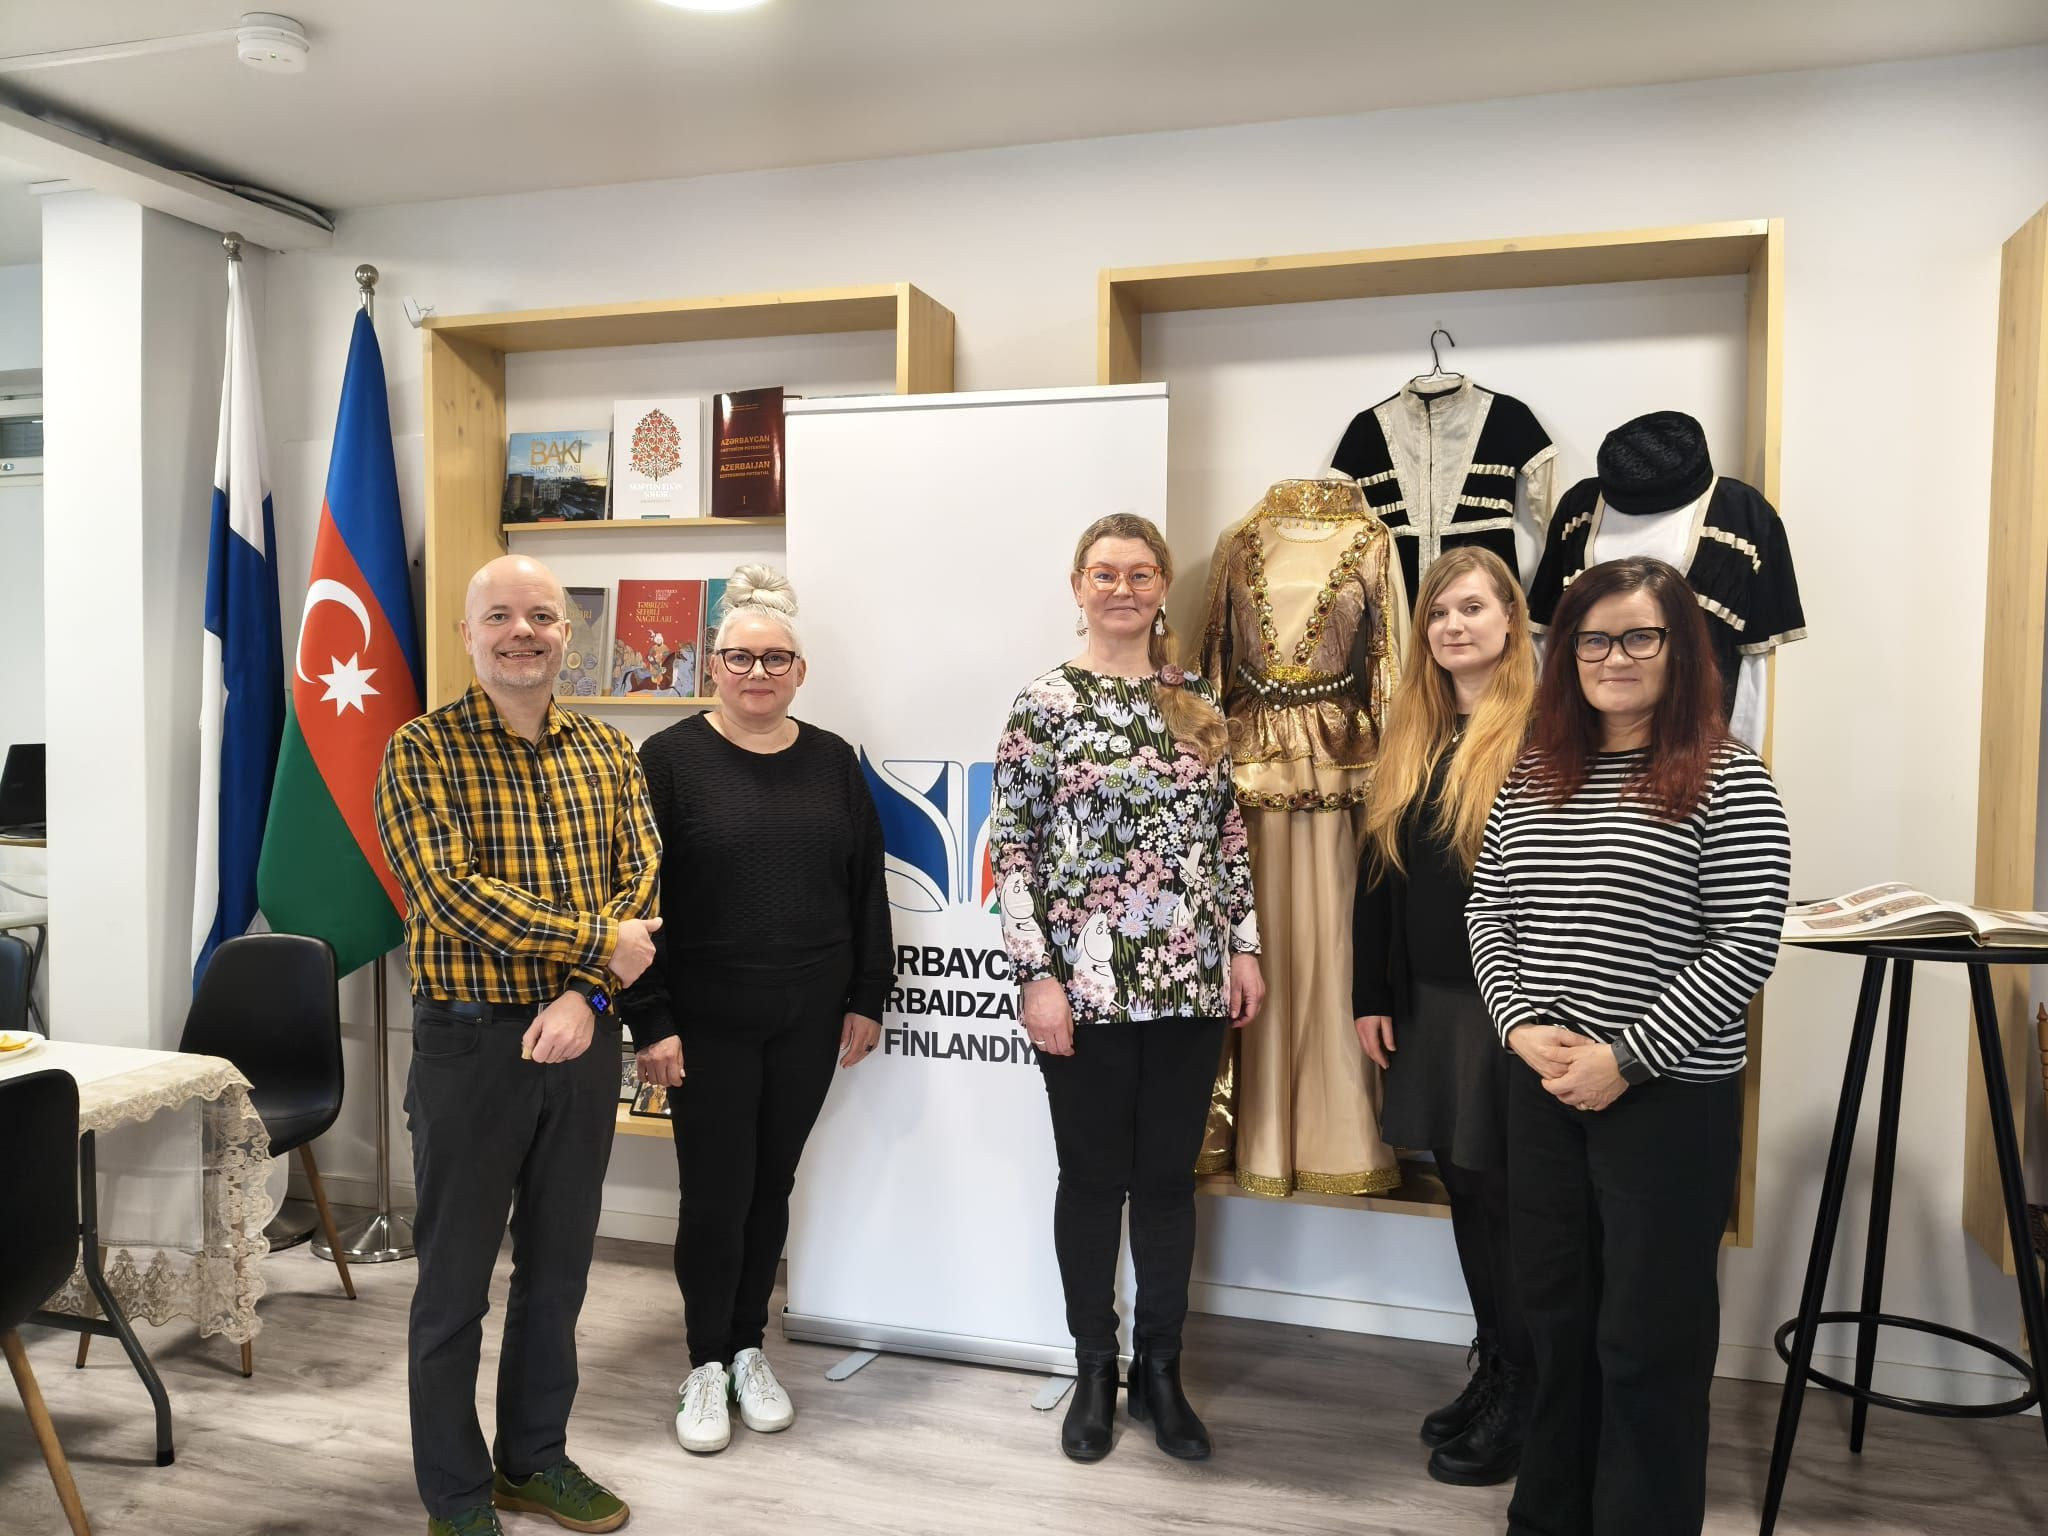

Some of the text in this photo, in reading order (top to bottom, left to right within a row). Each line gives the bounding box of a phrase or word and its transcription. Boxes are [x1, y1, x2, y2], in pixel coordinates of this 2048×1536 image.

[531, 439, 582, 465] BAKI
[720, 434, 770, 446] AZƏRBAYCAN
[720, 461, 770, 472] AZERBAIJAN
[896, 944, 1013, 981] RBAYC
[884, 986, 1021, 1021] RBAIDZA
[884, 1021, 1040, 1066] FİNLANDİY
